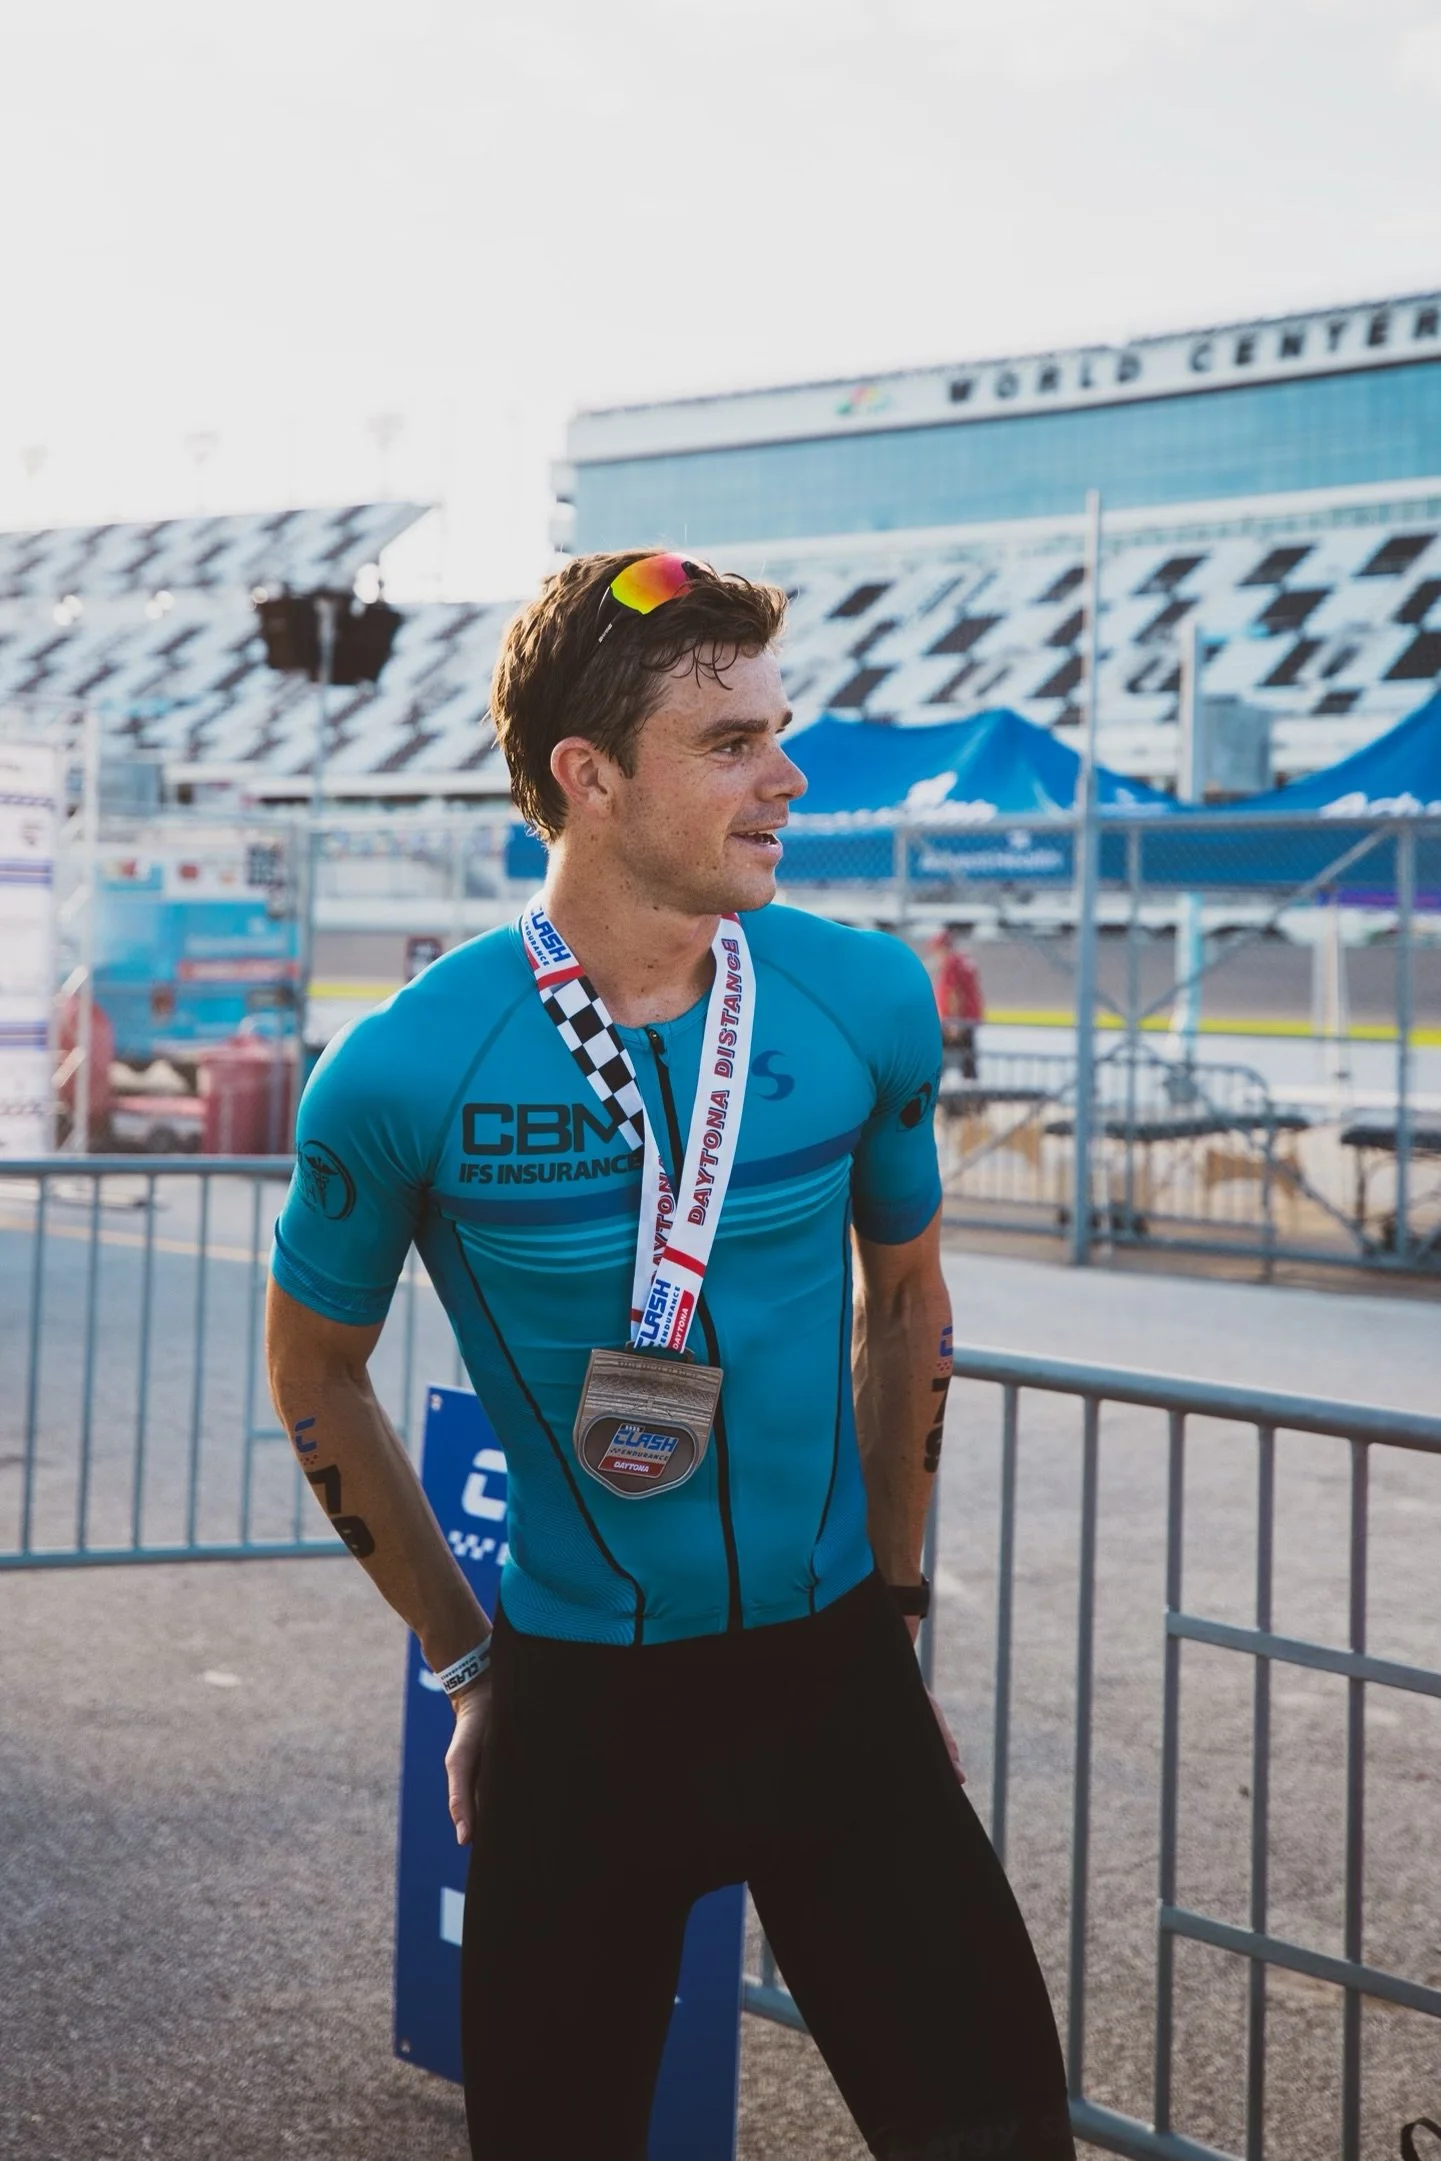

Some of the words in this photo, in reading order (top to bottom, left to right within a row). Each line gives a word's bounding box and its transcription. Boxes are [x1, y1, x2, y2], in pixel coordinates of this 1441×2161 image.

[948, 352, 1142, 404] WORLD
[1189, 307, 1439, 374] CENTER
[530, 905, 571, 963] LASH
[687, 1089, 730, 1226] DAYTONA
[713, 938, 742, 1078] DISTANCE
[459, 1163, 493, 1184] IFS
[496, 1153, 642, 1185] INSURANCE
[661, 1286, 680, 1343] ENDURANCE
[673, 1308, 688, 1349] DAYTONA
[613, 1430, 677, 1452] CLASH
[613, 1461, 649, 1472] DAYTONA
